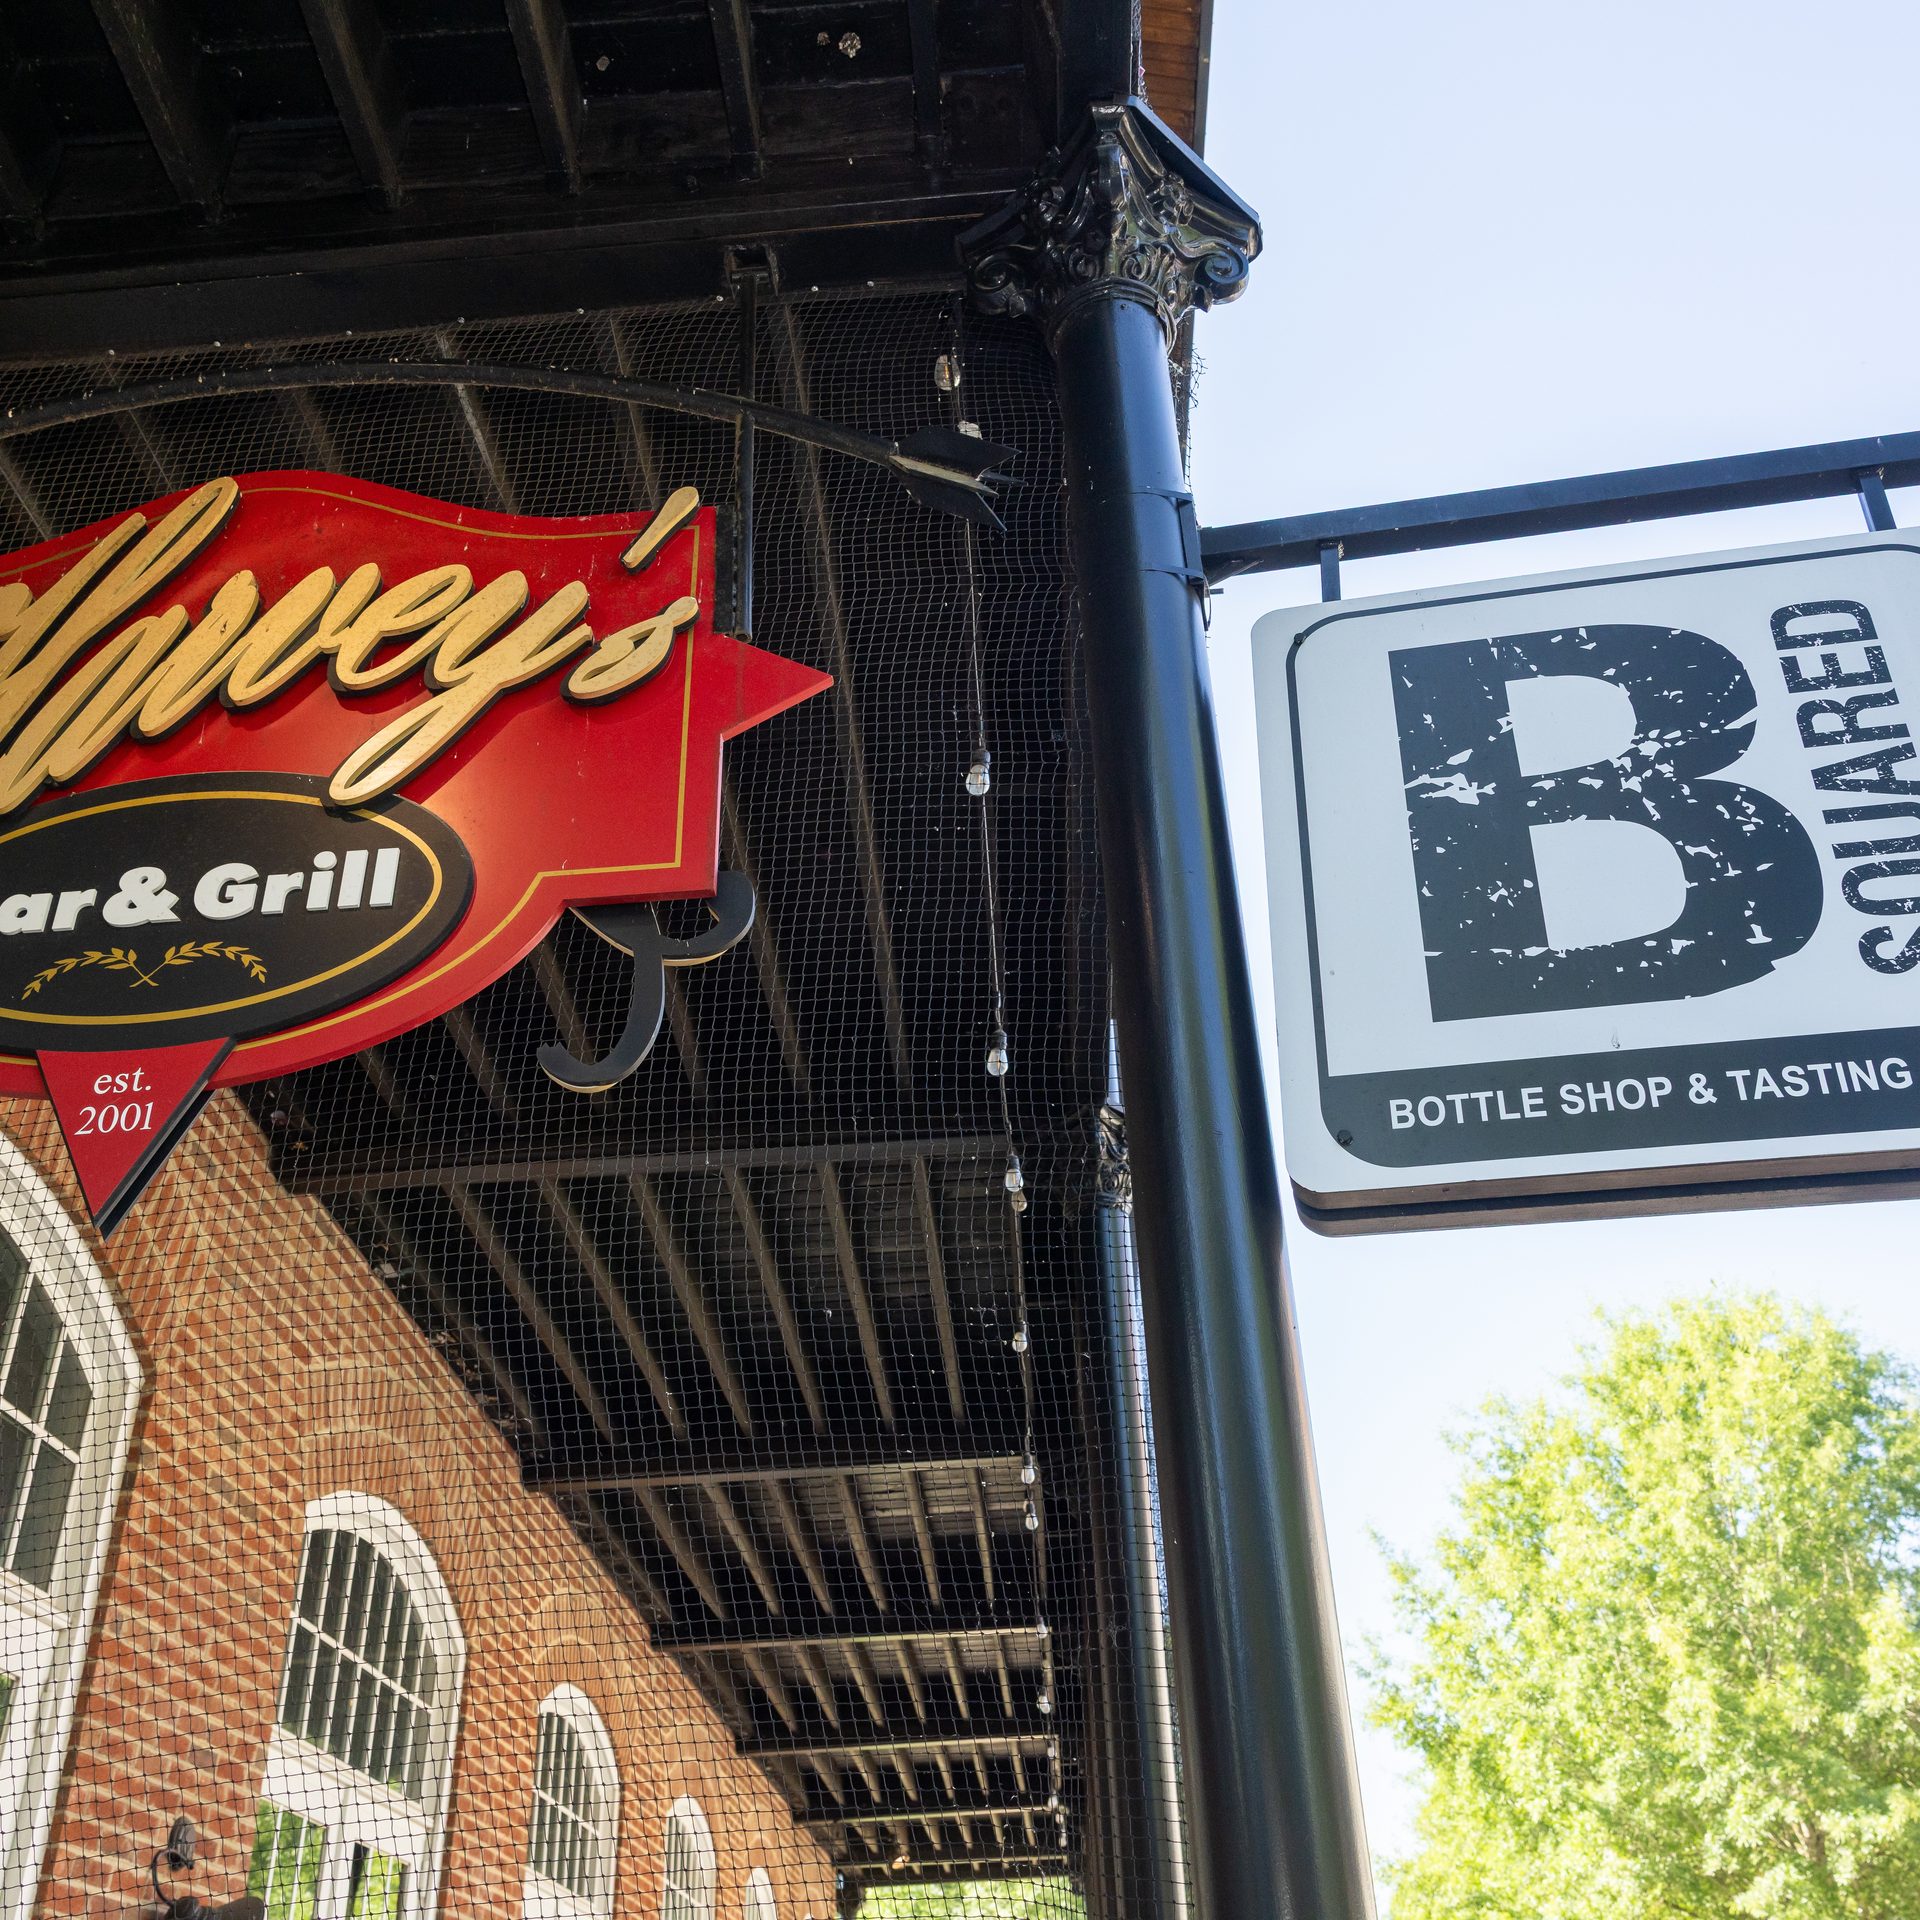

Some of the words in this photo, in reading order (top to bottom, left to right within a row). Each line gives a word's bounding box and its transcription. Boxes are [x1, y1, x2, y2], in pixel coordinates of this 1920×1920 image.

[1387, 623, 1824, 1023] B
[1769, 599, 1920, 975] SQUARED
[0, 888, 98, 936] ar
[102, 866, 182, 928] &
[193, 847, 401, 921] Grill
[73, 1102, 154, 1136] 2001
[93, 1066, 153, 1095] est.
[1389, 1086, 1548, 1130] BOTTLE
[1559, 1076, 1673, 1115] SHOP
[1688, 1072, 1718, 1105] &
[1725, 1057, 1913, 1102] TASTING
